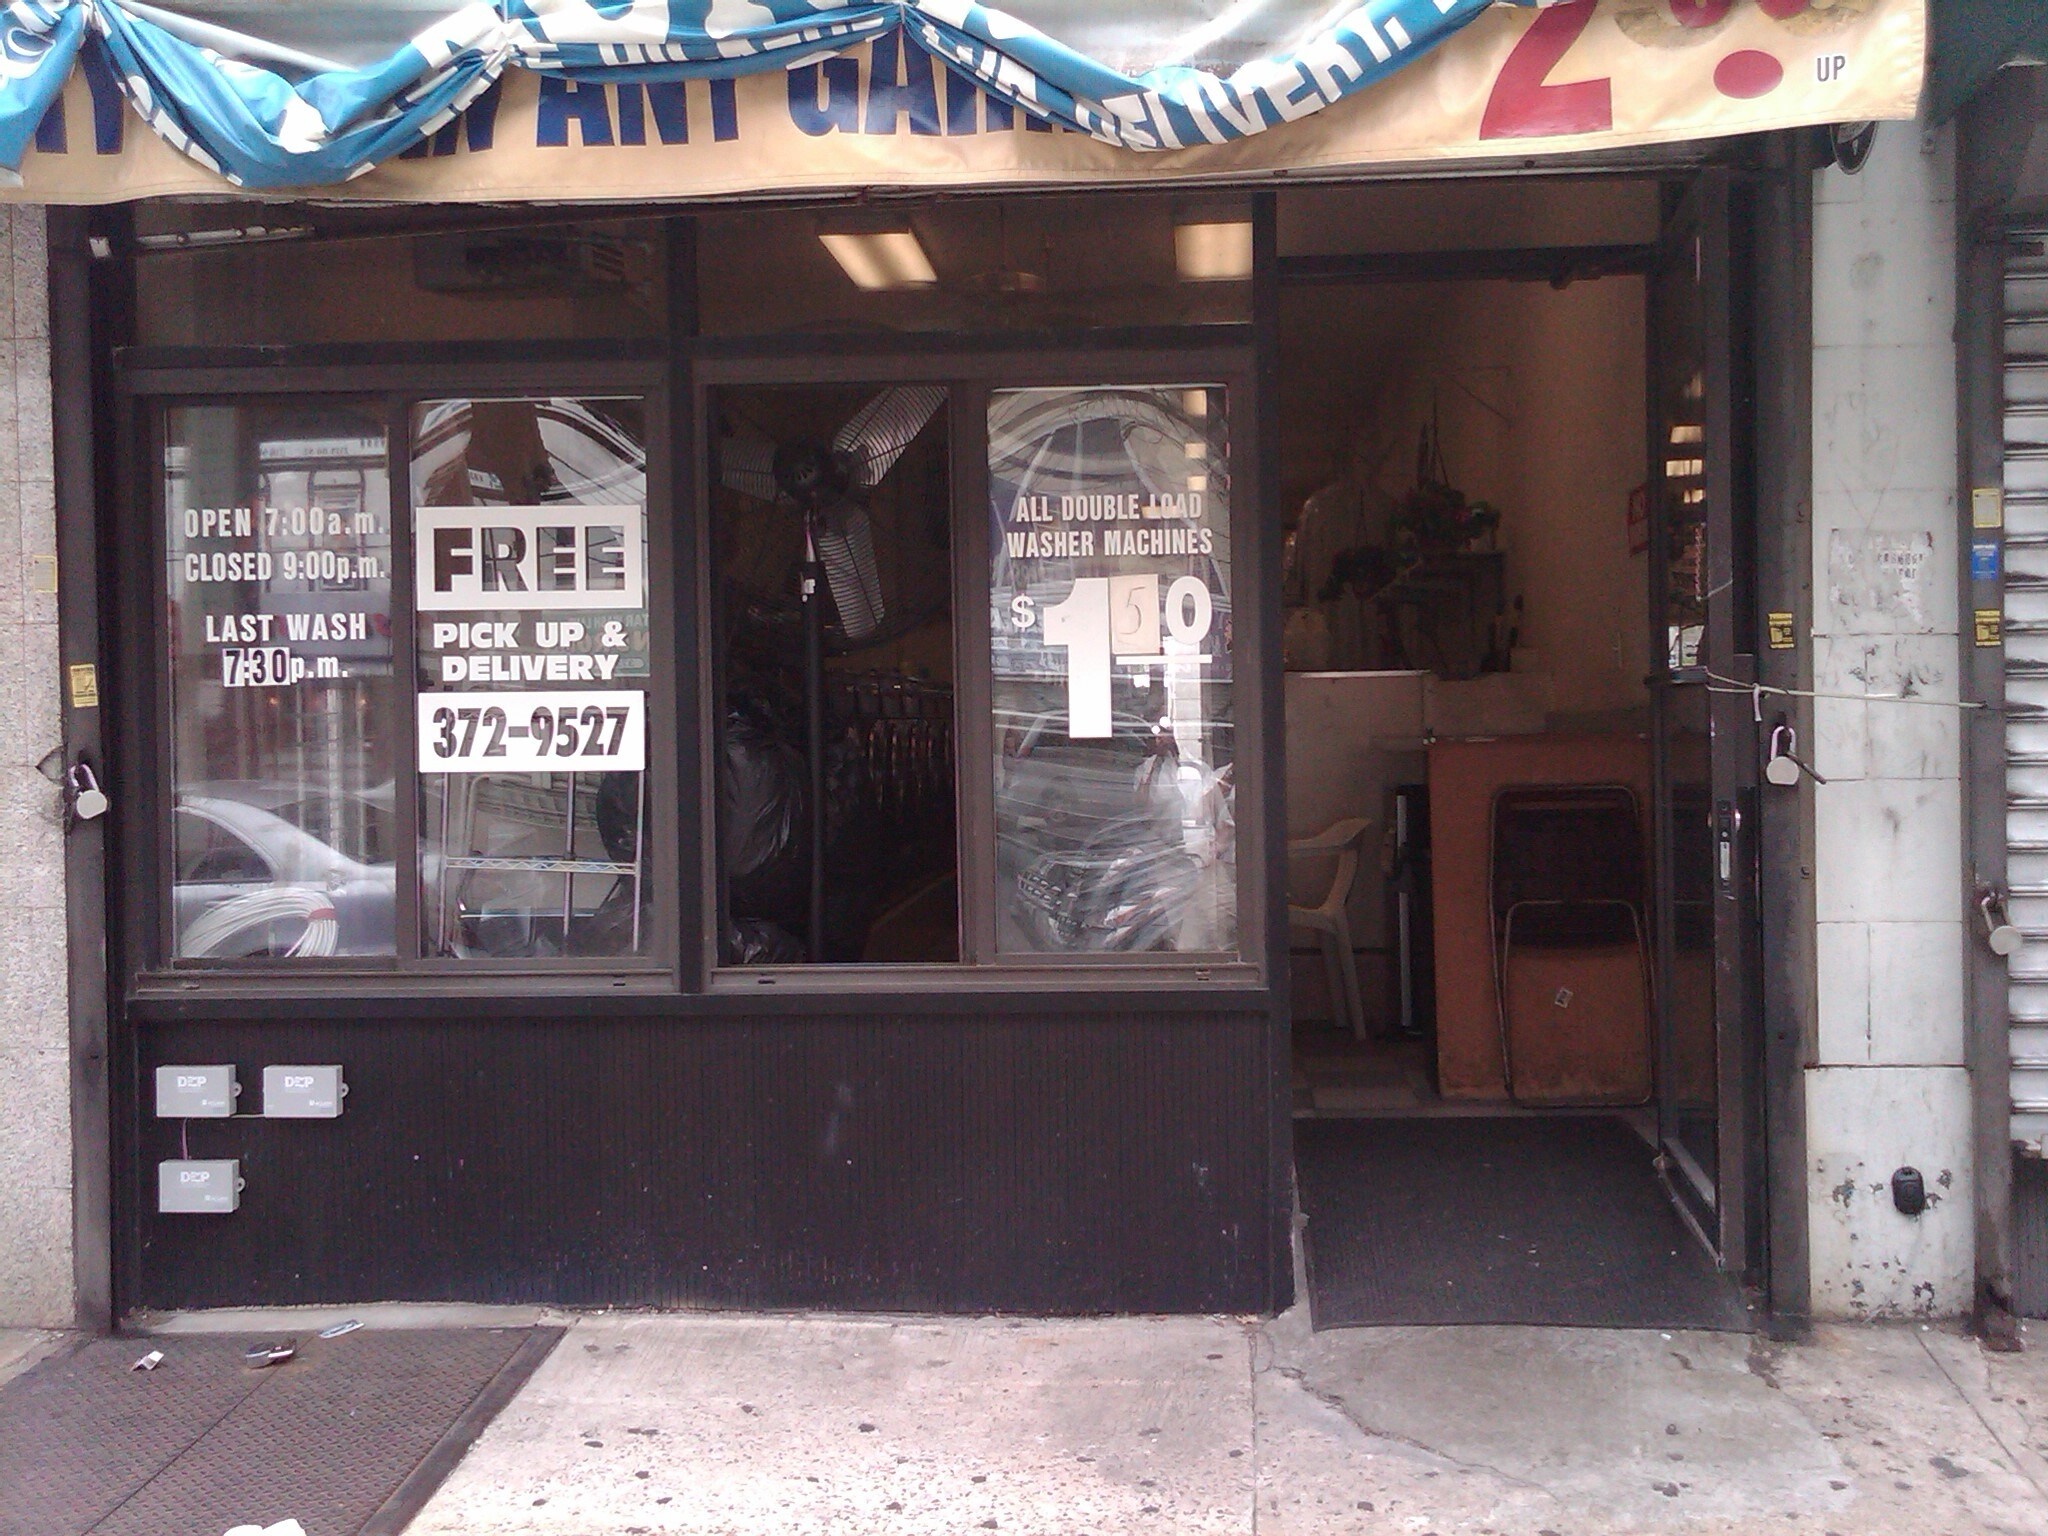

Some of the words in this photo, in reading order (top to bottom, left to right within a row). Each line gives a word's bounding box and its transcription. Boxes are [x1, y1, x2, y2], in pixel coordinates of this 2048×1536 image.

[1816, 55, 1846, 82] UP
[184, 508, 251, 538] OPEN
[1016, 496, 1053, 523] ALL
[1061, 494, 1140, 520] DOUBLE
[1149, 493, 1202, 519] LOAD
[1006, 530, 1095, 558] WASHER
[1104, 528, 1214, 556] MACHINES
[184, 552, 272, 582] CLOSED
[433, 526, 626, 592] FREE
[206, 615, 274, 642] LAST
[286, 613, 367, 641] WASH
[433, 622, 520, 649] PICK
[535, 622, 585, 648] UP
[601, 620, 628, 647] &
[442, 654, 620, 682] DELIVERY
[432, 706, 630, 758] 372-9527
